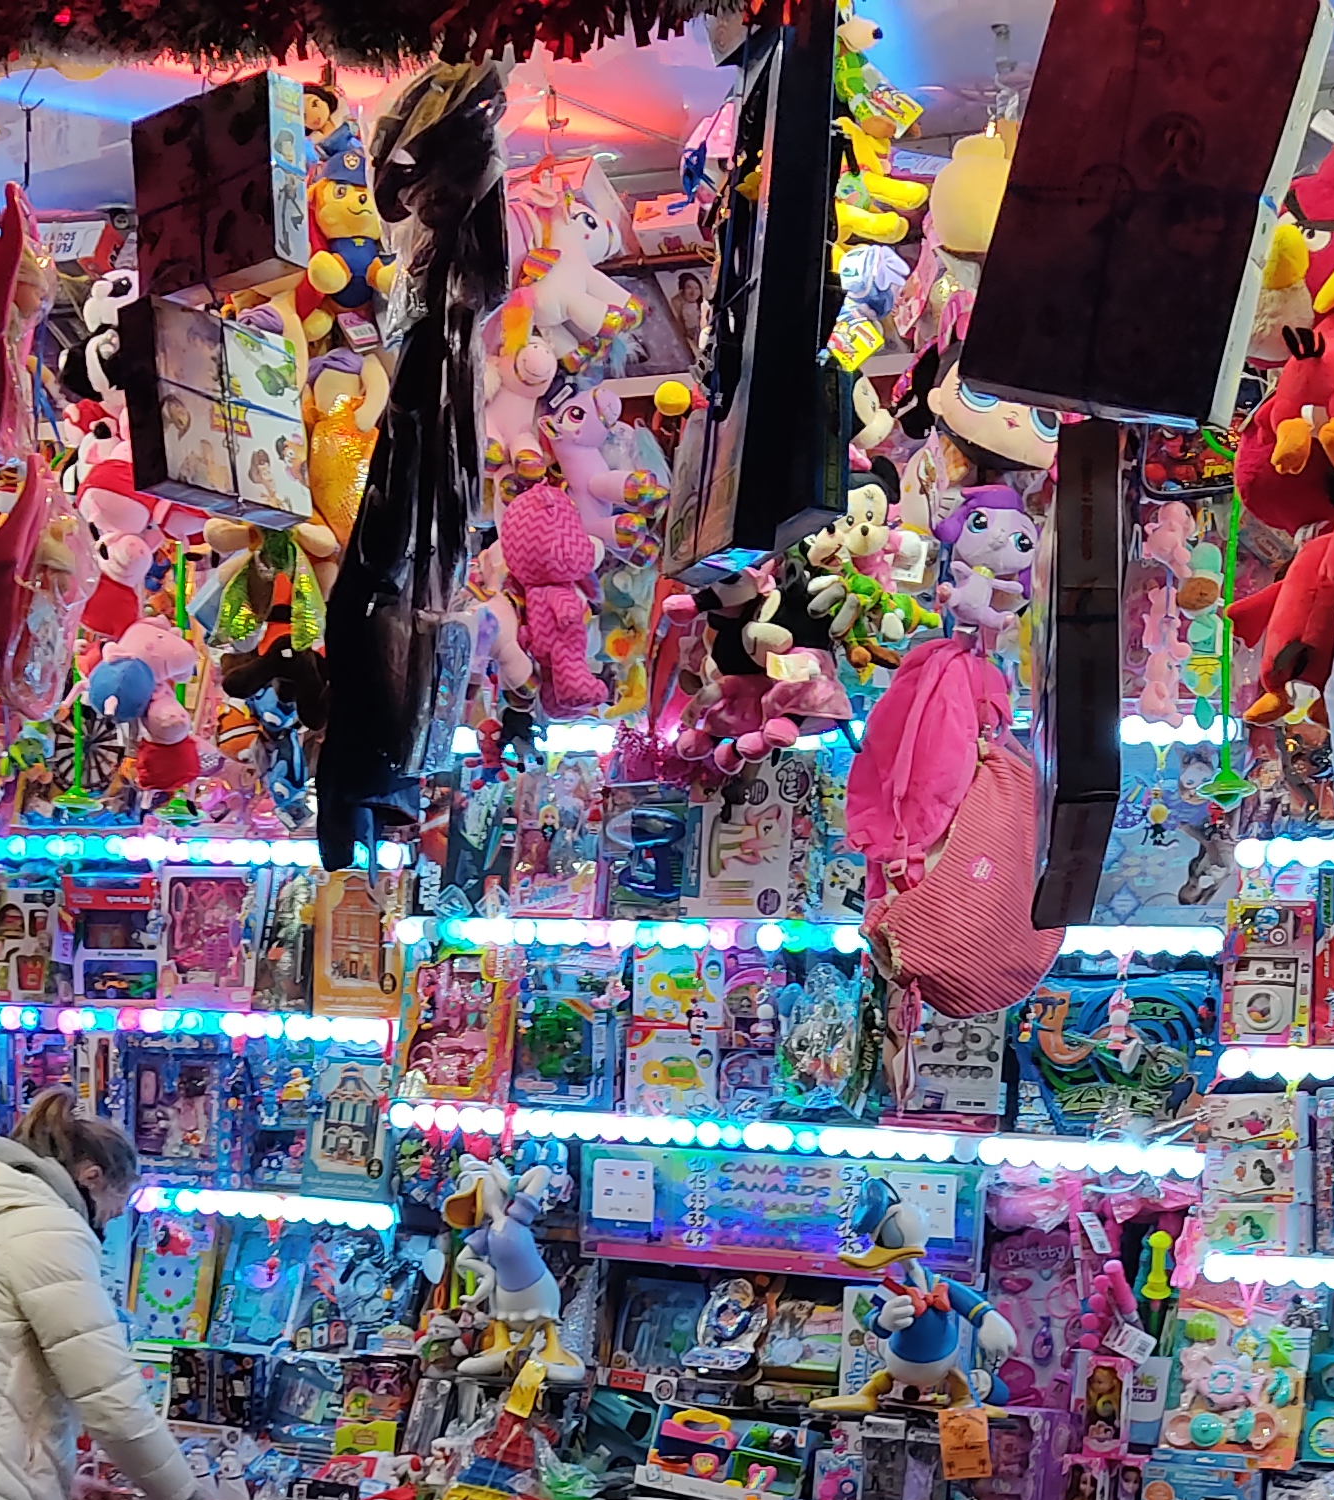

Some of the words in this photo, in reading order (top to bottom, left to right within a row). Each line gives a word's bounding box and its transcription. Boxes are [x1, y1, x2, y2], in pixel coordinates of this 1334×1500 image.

[720, 1162, 832, 1180] CANARDS
[718, 1178, 831, 1198] CANARDS
[688, 1211, 707, 1227] 39
